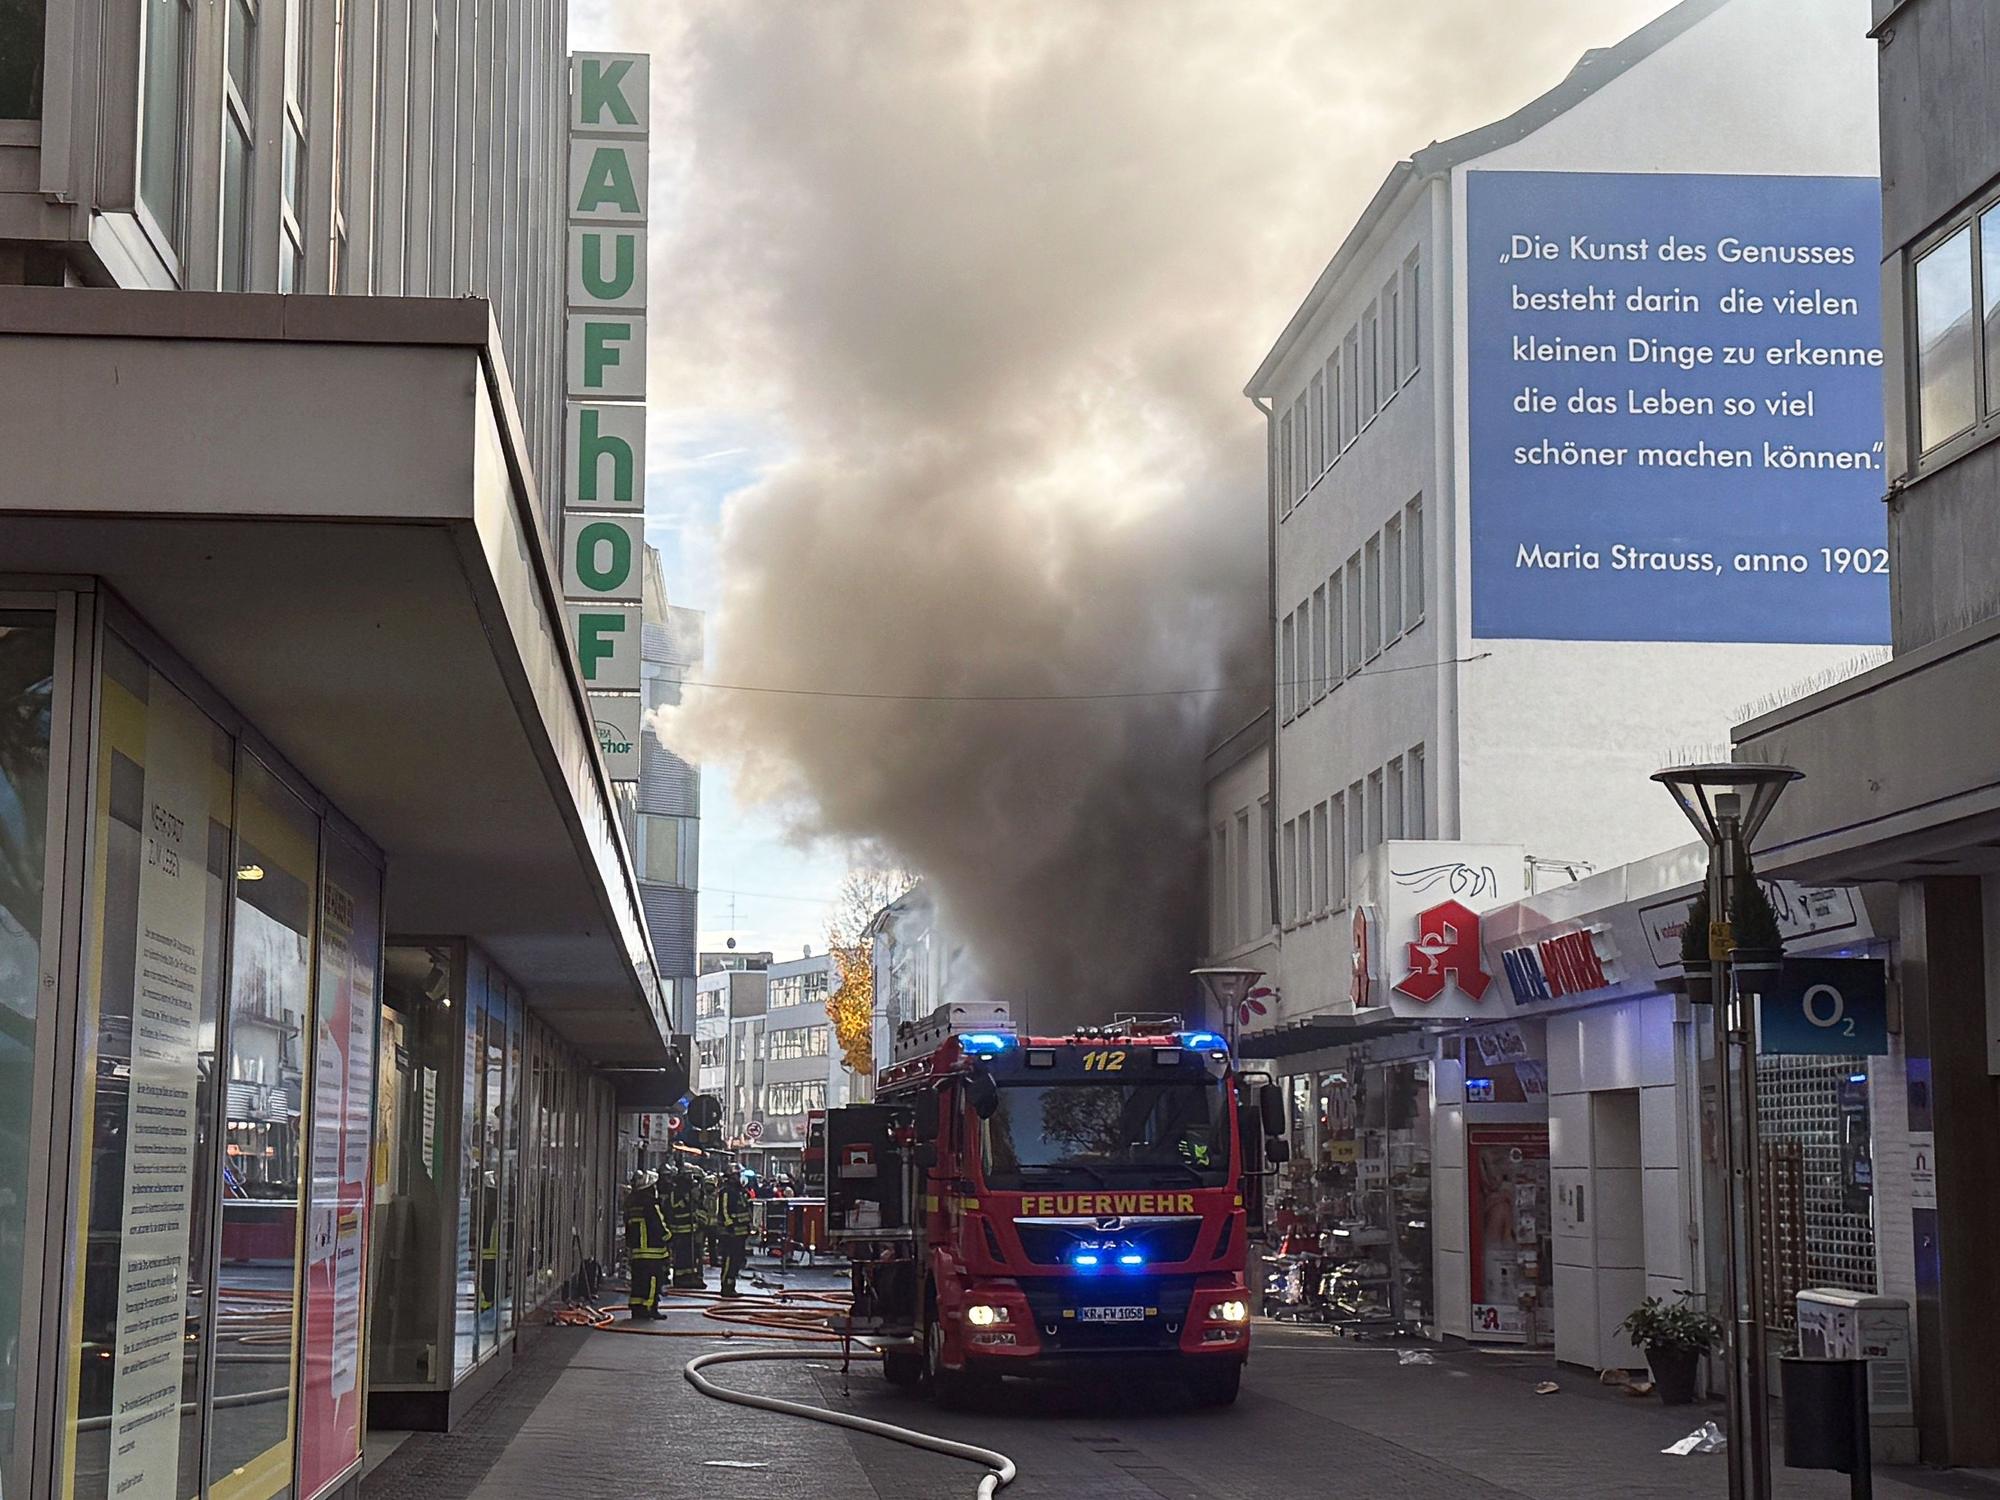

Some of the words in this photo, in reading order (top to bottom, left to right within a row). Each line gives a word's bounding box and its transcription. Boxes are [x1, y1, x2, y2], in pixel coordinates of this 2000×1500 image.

[1499, 234, 1560, 264] „Die
[1570, 235, 1649, 261] Kunst
[1658, 235, 1707, 262] des
[1717, 237, 1855, 265] Genusses
[1512, 284, 1617, 311] besteht
[1626, 286, 1699, 312] darin
[1719, 287, 1764, 314] die
[1772, 288, 1858, 315] vielen
[1513, 335, 1617, 362] kleinen
[1628, 338, 1714, 370] Dinge
[1722, 347, 1755, 365] zu
[1513, 386, 1557, 413] die
[1567, 387, 1618, 414] das
[1628, 388, 1714, 415] Leben
[1723, 398, 1756, 416] so
[1765, 390, 1814, 417] viel
[1514, 438, 1628, 466] schöner
[1638, 440, 1752, 468] machen
[1515, 543, 1600, 570] Maria
[1611, 544, 1722, 576] Strauss,
[1733, 554, 1808, 573] anno
[1820, 547, 1890, 574] 1902
[1083, 1050, 1128, 1071] 112
[1021, 1193, 1195, 1216] FEUERWEHR
